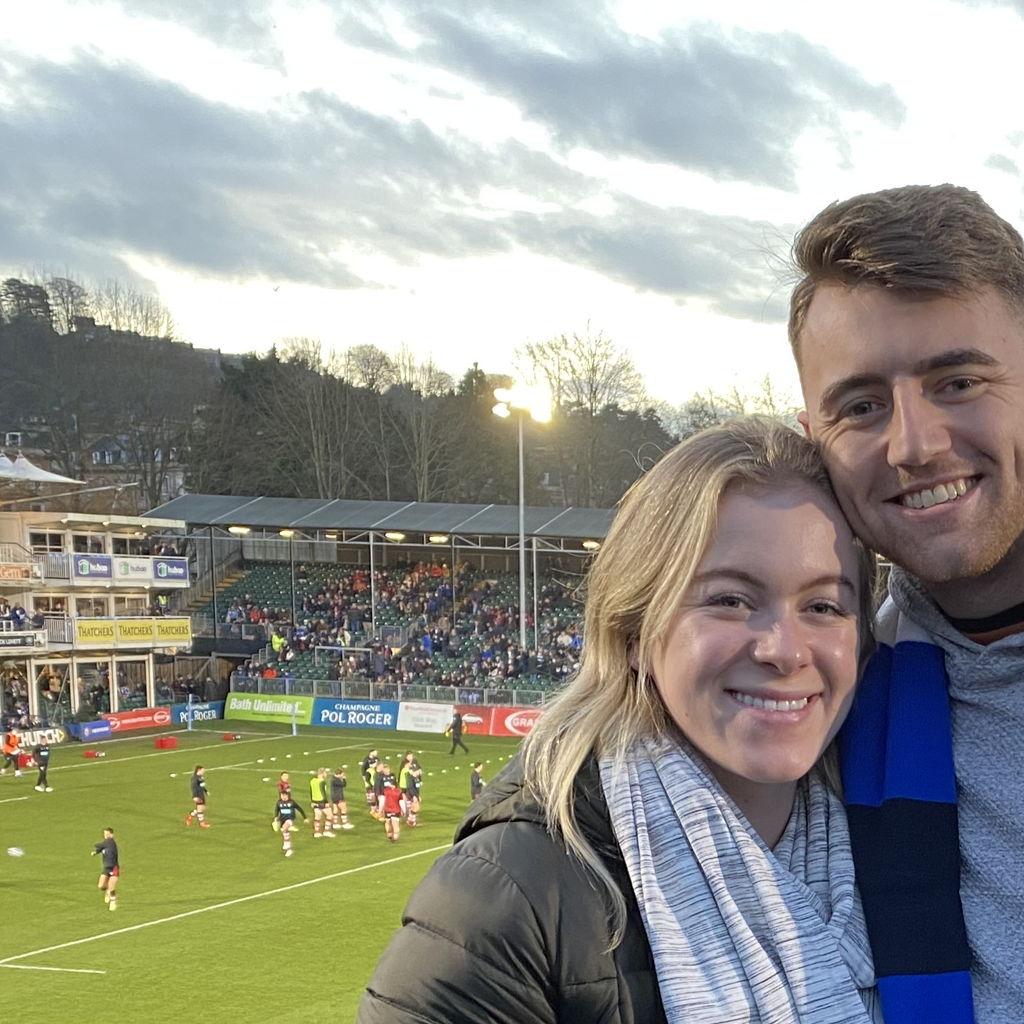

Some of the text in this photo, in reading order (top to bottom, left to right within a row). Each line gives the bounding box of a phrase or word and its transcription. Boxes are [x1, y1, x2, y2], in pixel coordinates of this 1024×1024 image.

[78, 626, 114, 637] THATCHERS
[118, 625, 153, 636] THATCHERS
[157, 624, 189, 635] THATCHERS
[229, 698, 252, 710] Bath
[334, 703, 381, 711] CHAMPAGNE
[194, 710, 216, 720] ROGER
[321, 709, 346, 723] POL
[347, 711, 392, 725] ROGER
